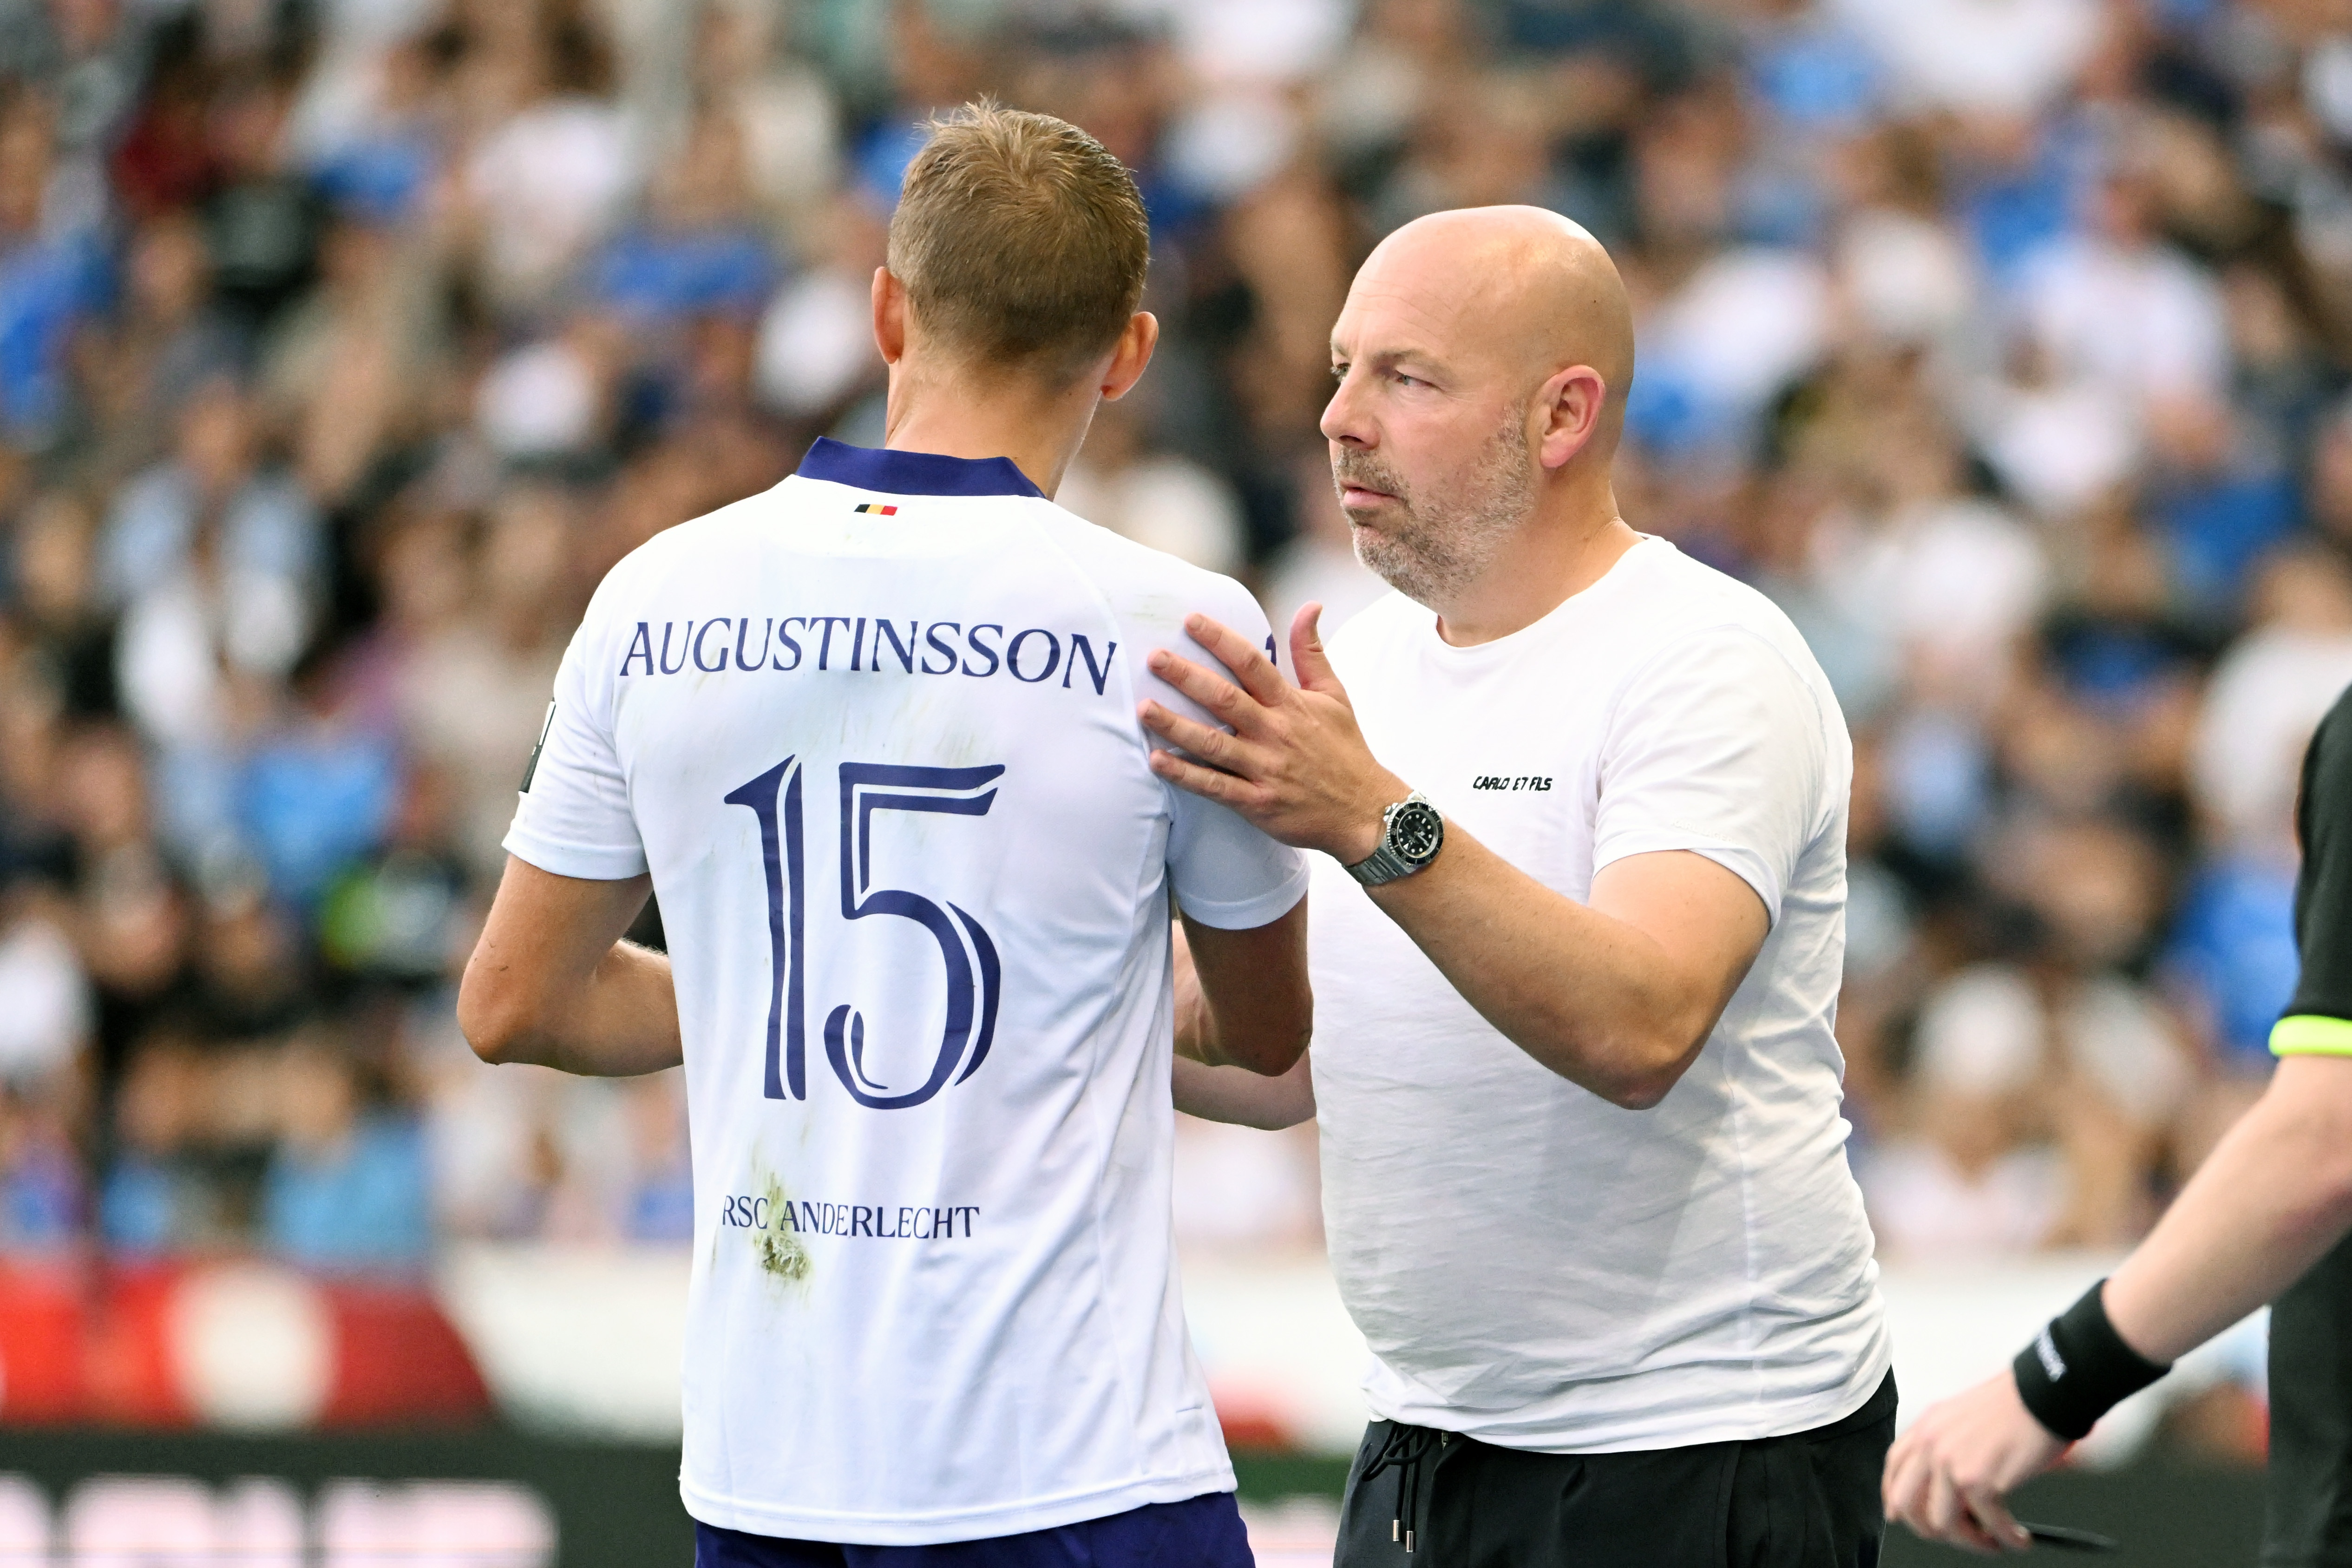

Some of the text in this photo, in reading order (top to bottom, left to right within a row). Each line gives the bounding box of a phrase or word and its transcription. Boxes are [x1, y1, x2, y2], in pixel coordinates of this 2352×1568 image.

[619, 617, 1117, 695] AUGUSTINSSON
[1473, 776, 1553, 791] CARLO ET FILS
[724, 754, 1006, 1110] 15
[722, 1195, 980, 1239] RSC ANDERLECHT
